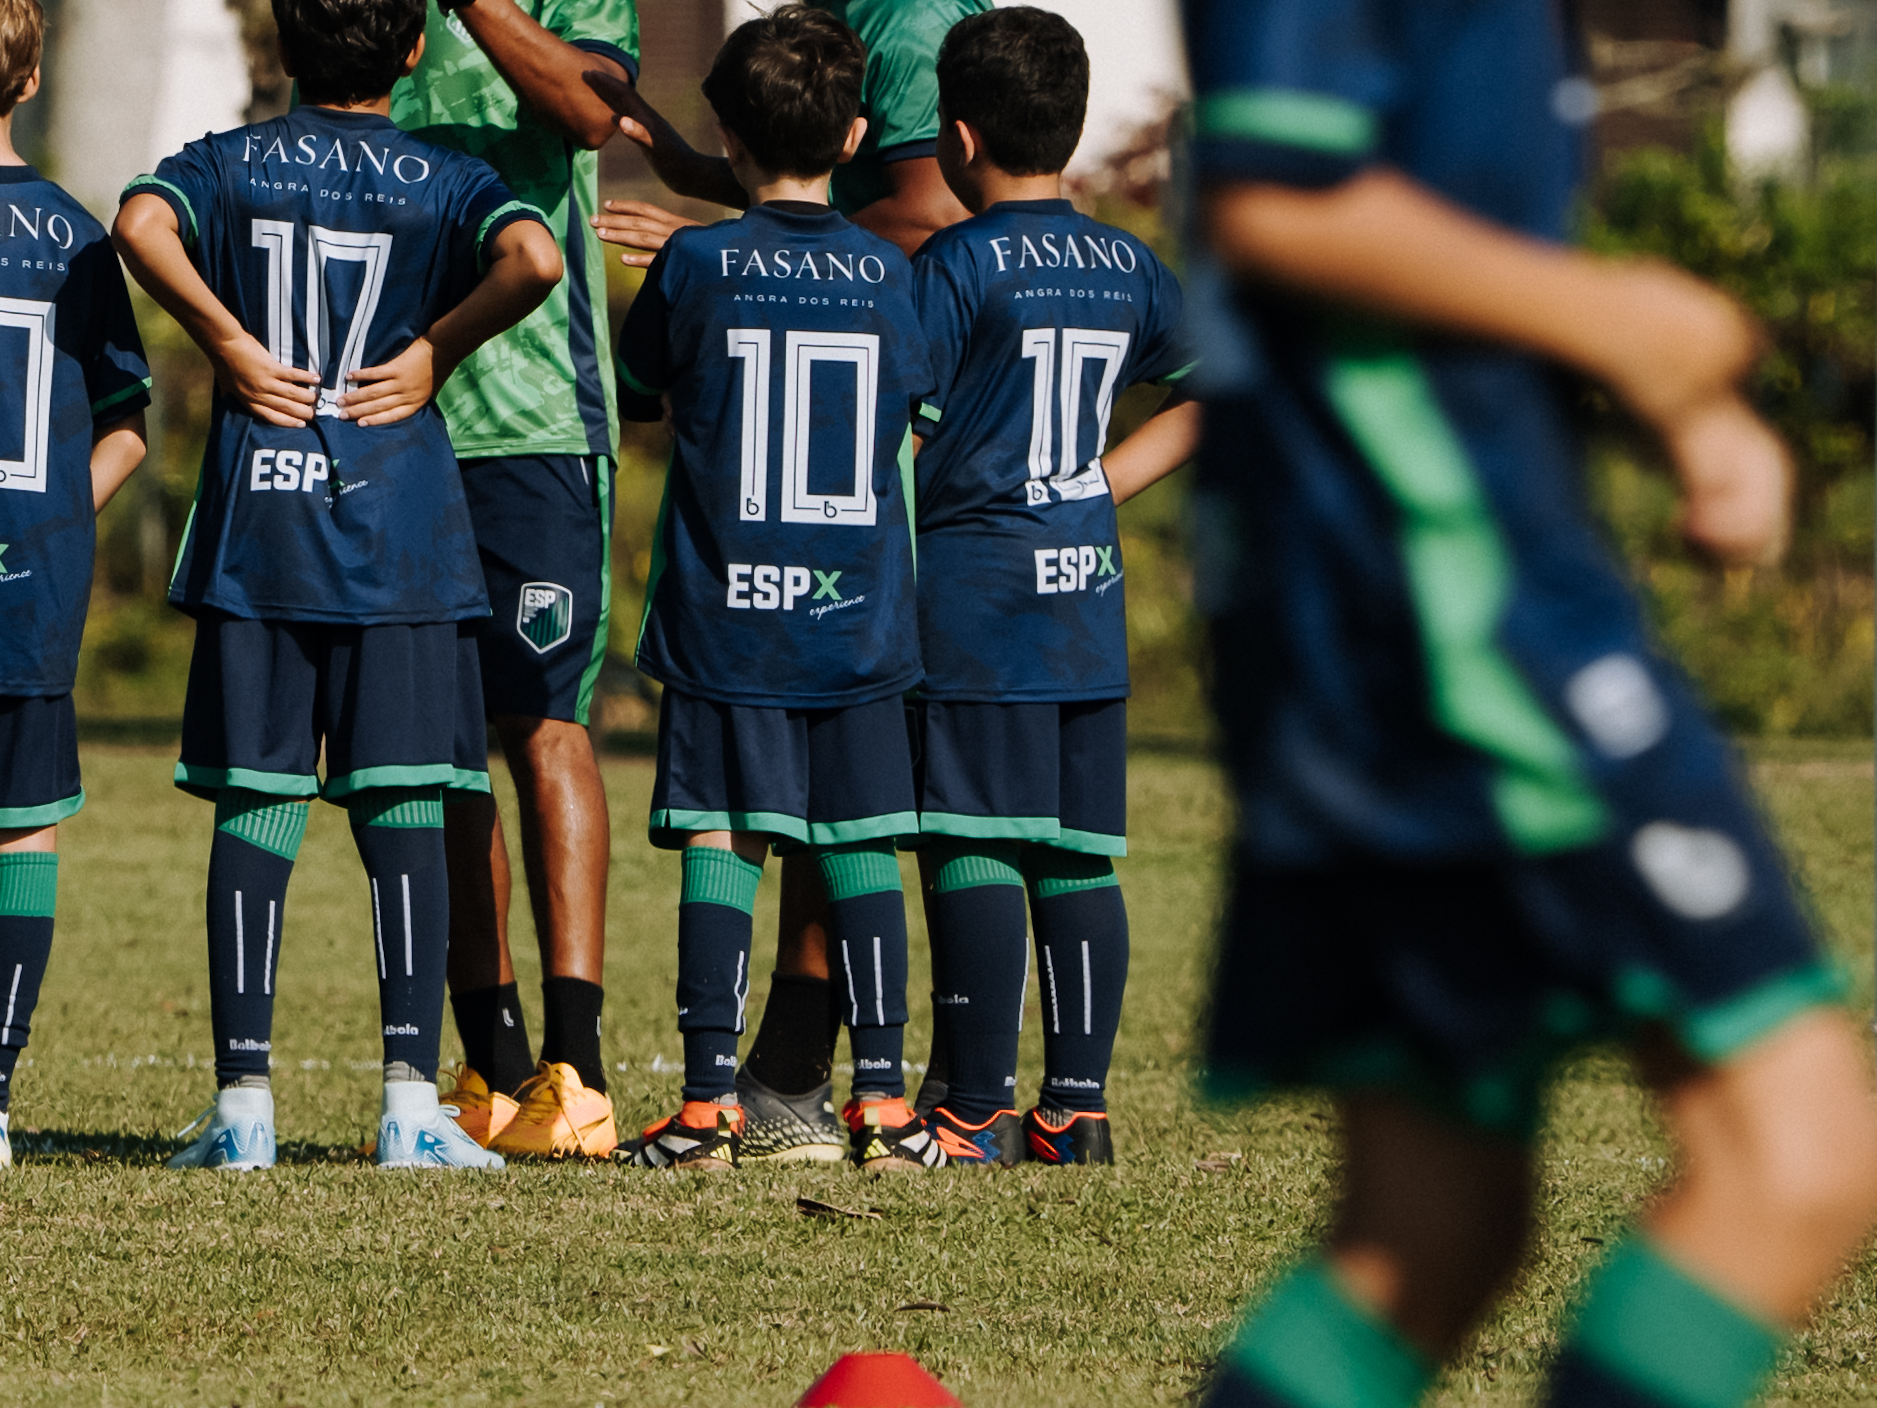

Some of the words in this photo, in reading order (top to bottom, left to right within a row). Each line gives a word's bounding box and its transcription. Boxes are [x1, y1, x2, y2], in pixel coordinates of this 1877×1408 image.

[242, 133, 430, 184] FASANO
[249, 177, 309, 192] ANGRA
[320, 189, 353, 201] DOS
[364, 193, 406, 205] REIS
[22, 260, 66, 271] REIS
[720, 248, 886, 284] FASANO
[988, 233, 1137, 274] FASANO
[733, 294, 788, 304] ANGRA
[798, 296, 830, 306] DOS
[840, 298, 874, 308] REIS
[1014, 288, 1062, 300] ANGRA
[727, 328, 880, 526] 10
[250, 449, 345, 492] ESP
[524, 588, 556, 609] ESP
[809, 595, 865, 621] experience
[229, 1038, 272, 1052] Batbol
